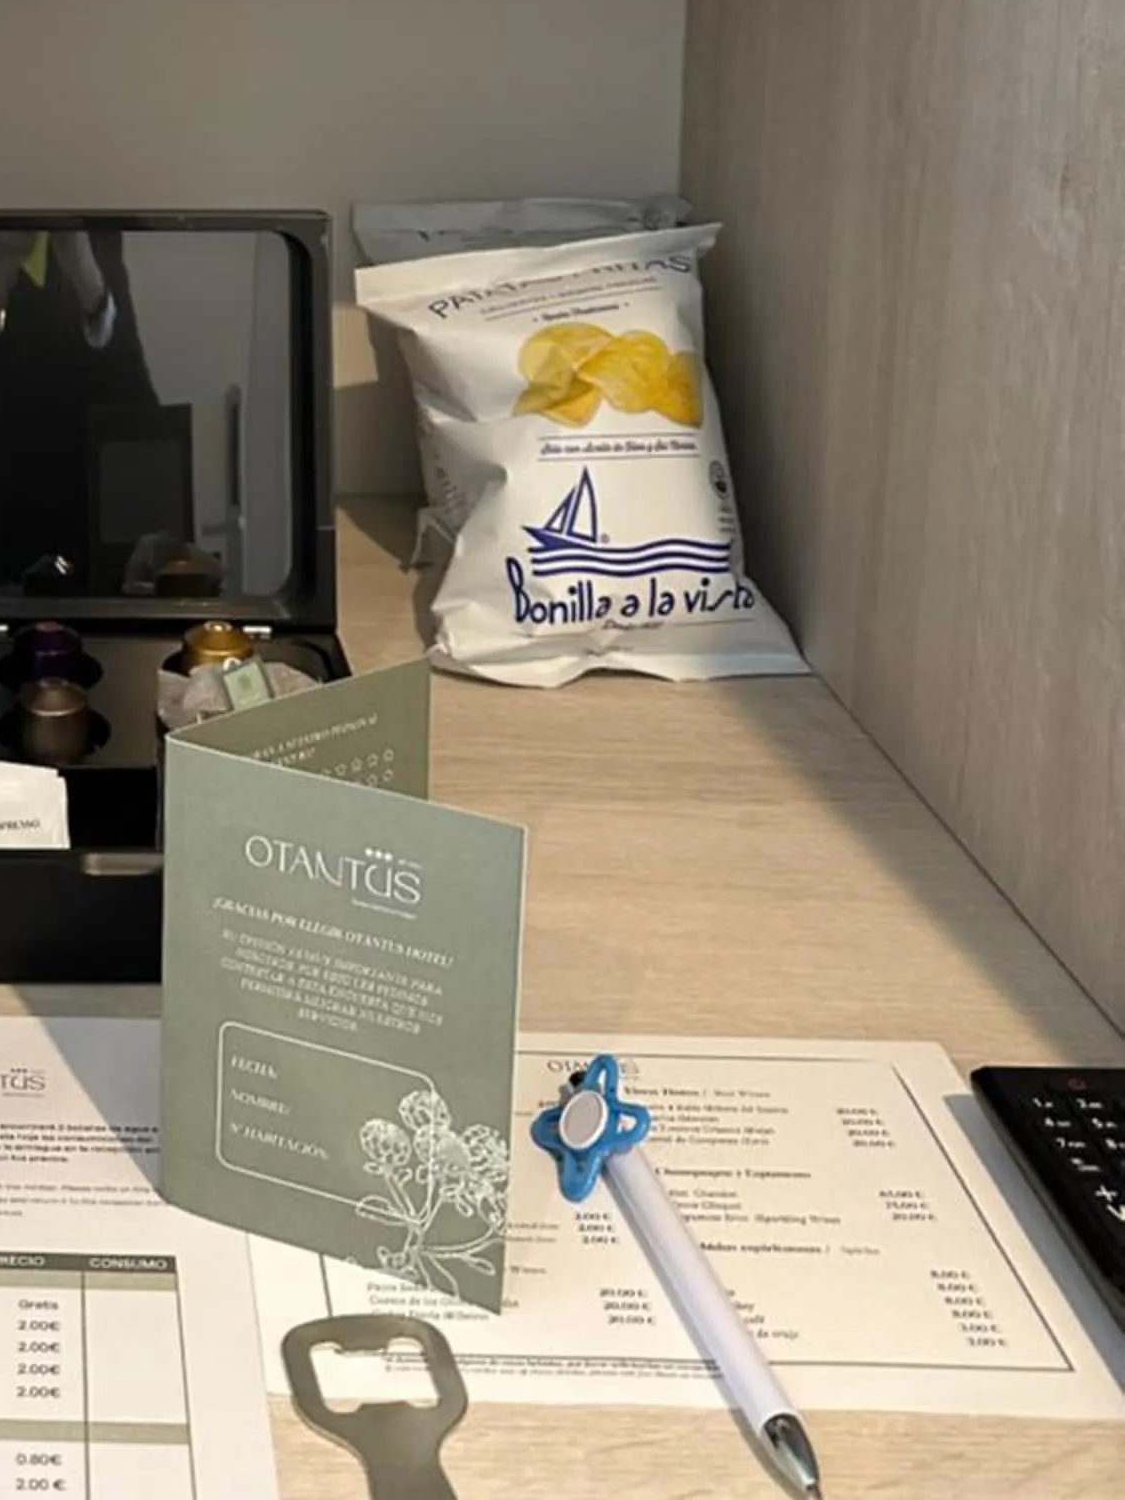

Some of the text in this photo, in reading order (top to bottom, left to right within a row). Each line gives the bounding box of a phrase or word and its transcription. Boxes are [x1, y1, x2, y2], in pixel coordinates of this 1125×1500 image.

[506, 556, 756, 625] Bonilla a la vista
[245, 835, 422, 904] OTANTUS
[88, 1256, 169, 1271] CONSUMO
[17, 1298, 61, 1312] Gratis
[17, 1319, 62, 1332] 2.00€
[16, 1341, 61, 1355] 2.00€
[16, 1362, 61, 1377] 2.00€
[16, 1385, 62, 1400] 2.00€
[15, 1451, 64, 1467] 0.80€
[15, 1476, 50, 1492] 2.00
